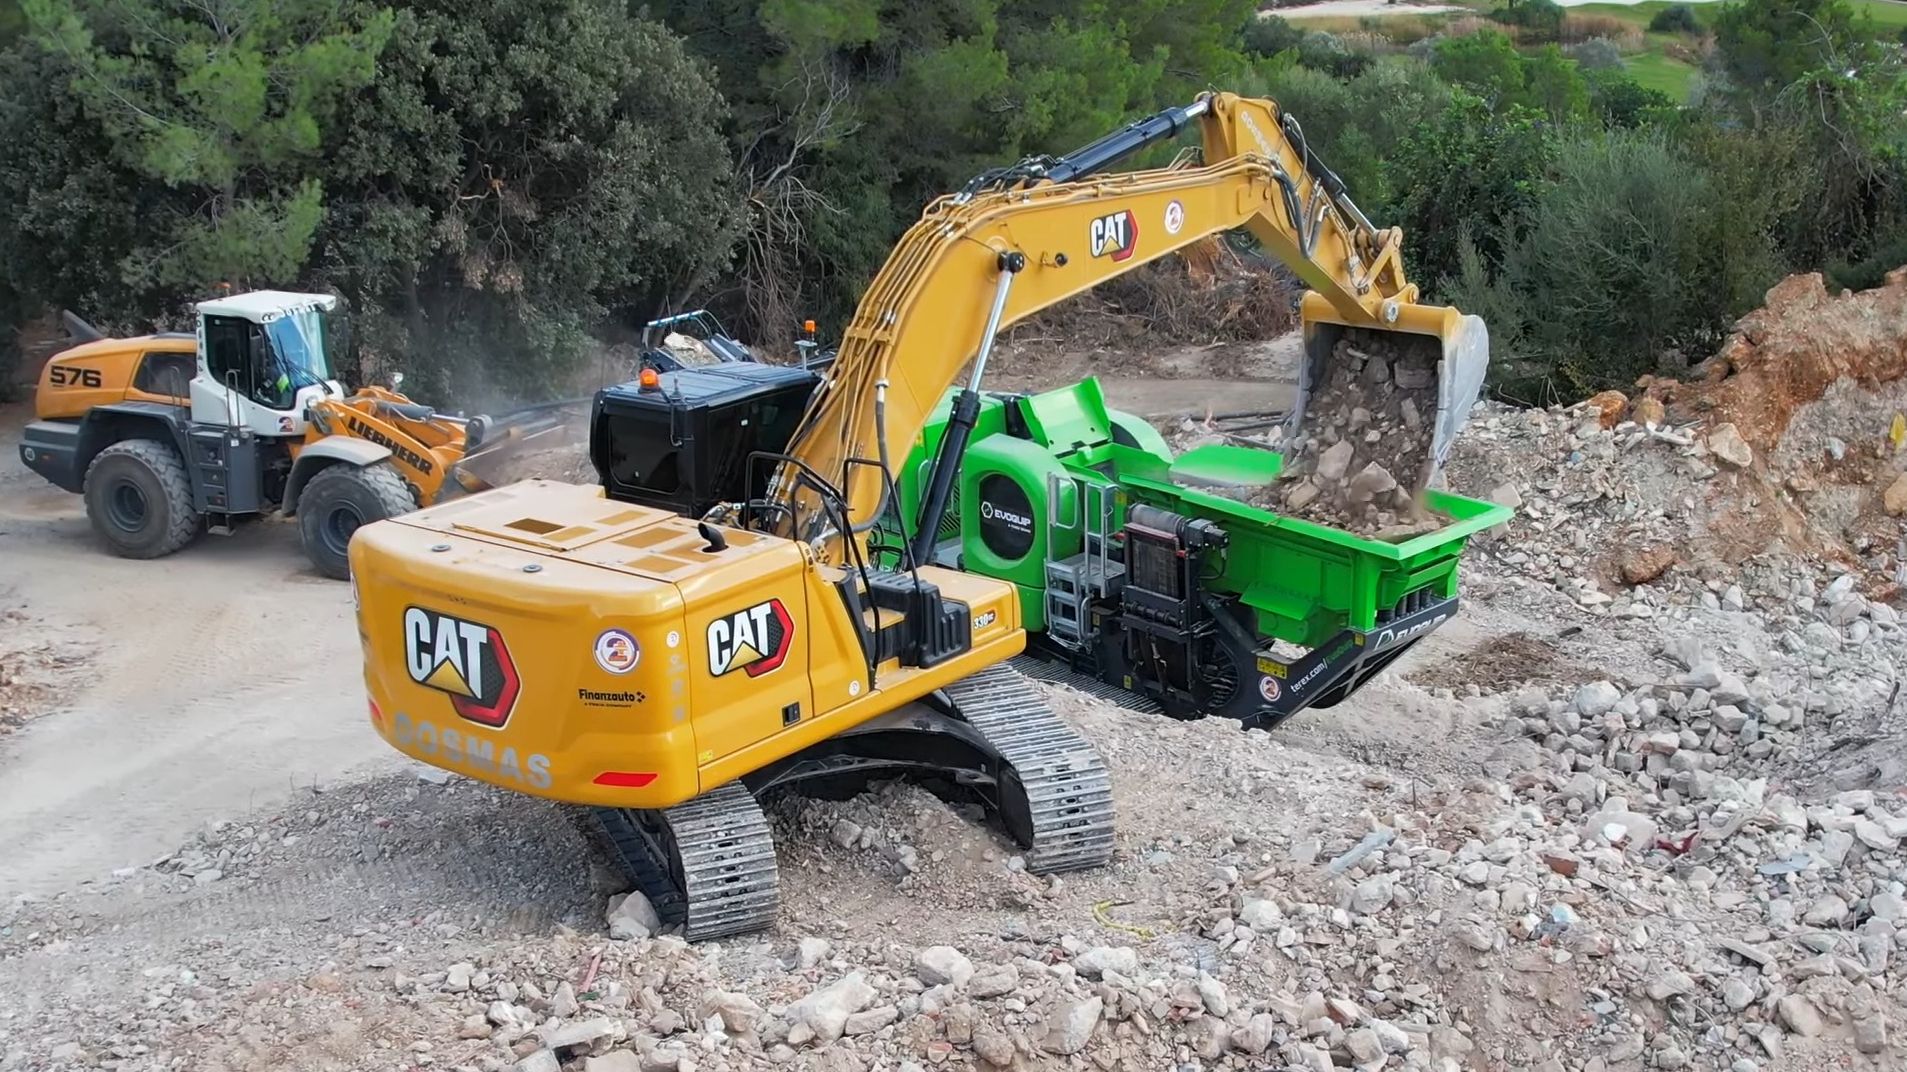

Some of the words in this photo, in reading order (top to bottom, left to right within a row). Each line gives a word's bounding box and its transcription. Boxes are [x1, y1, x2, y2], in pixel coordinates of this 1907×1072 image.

[1091, 211, 1127, 257] CAT
[50, 365, 101, 389] 576
[348, 415, 433, 476] LIEBHERR
[994, 509, 1031, 526] EVOQUIP
[974, 613, 988, 630] 330
[404, 606, 488, 700] CAT
[708, 602, 771, 677] CAT
[578, 688, 636, 702] Finanzauto
